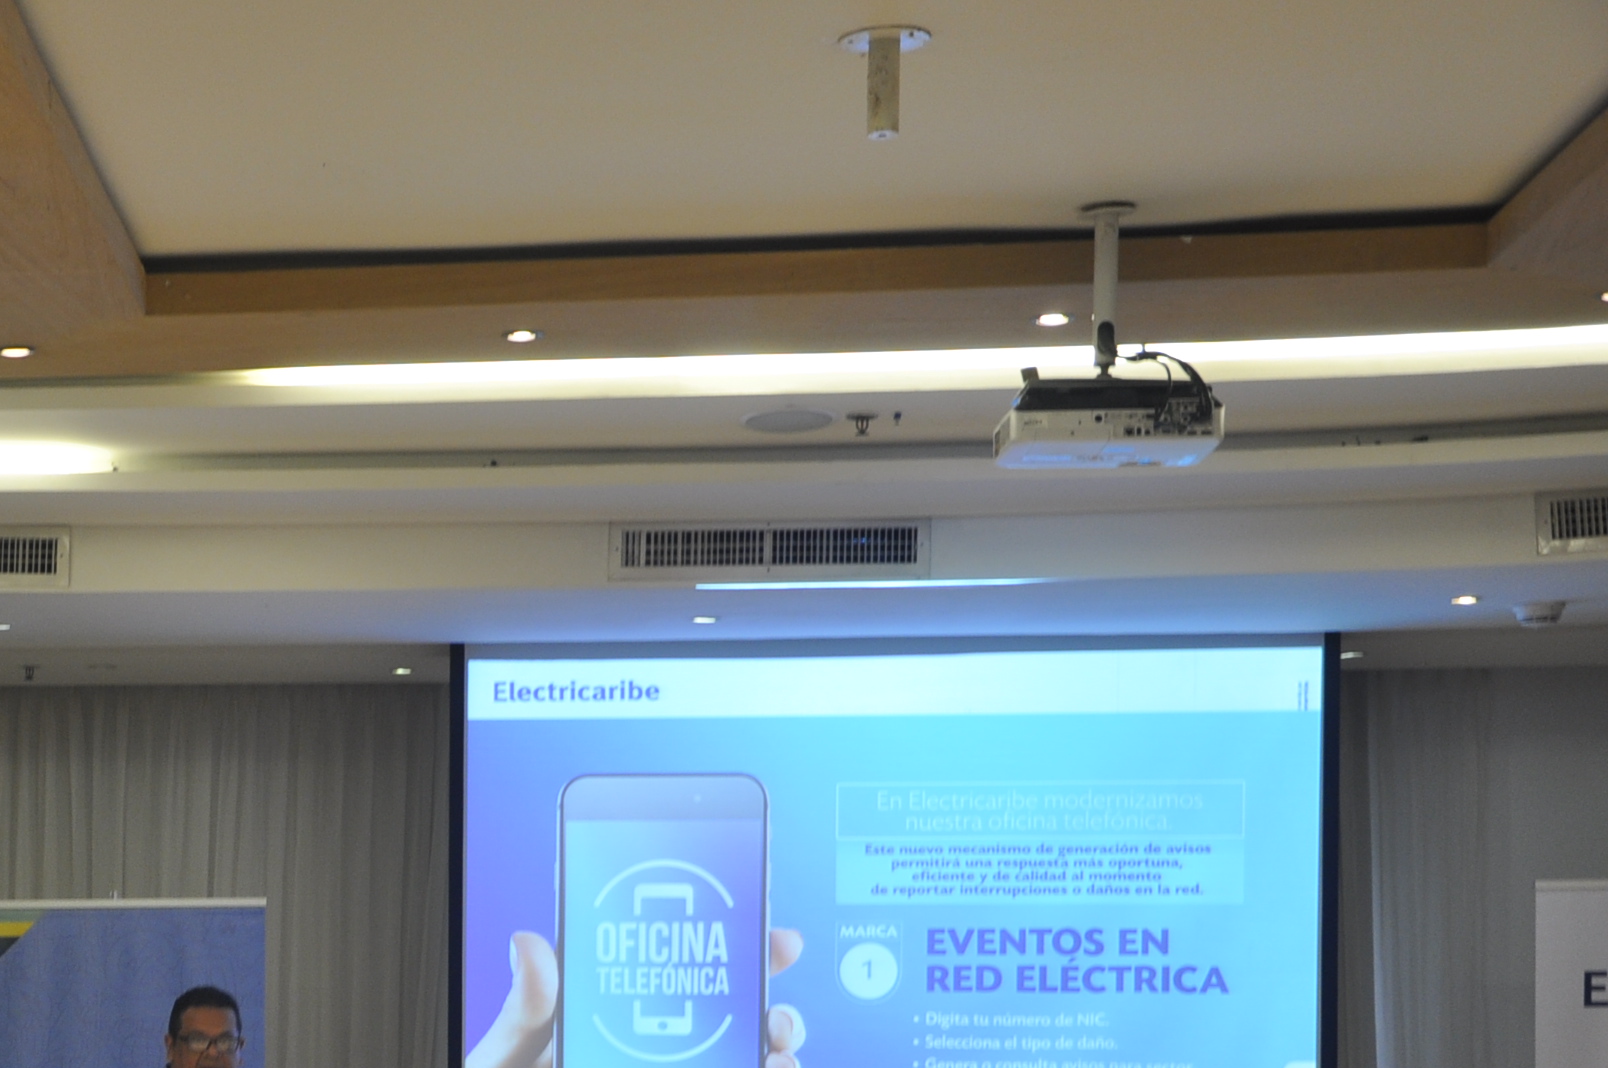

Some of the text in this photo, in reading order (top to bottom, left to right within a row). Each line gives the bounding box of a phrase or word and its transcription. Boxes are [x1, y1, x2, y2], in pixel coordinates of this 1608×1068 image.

[493, 680, 661, 703] Electricaribe
[876, 790, 1204, 812] En Electricaribe modernizamos
[905, 811, 1173, 832] nuestra oficina telefónica.
[864, 842, 1211, 858] Este nuevo mecanismo de generación de avisos
[891, 857, 960, 871] permitirá
[964, 860, 992, 869] una
[996, 858, 1068, 872] respuesta
[1073, 858, 1103, 869] más
[911, 869, 1162, 885] eficiente y de calidad al momento
[870, 883, 1204, 899] de reportar interrupciones o daños en la red.
[596, 920, 728, 964] OFICINA
[839, 924, 898, 939] MARCA
[926, 928, 1170, 956] EVENTOS EN
[596, 961, 729, 996] TELEFÓNICA
[861, 959, 874, 981] 1
[926, 957, 1230, 994] RED ELÉCTRICA
[925, 1011, 1110, 1030] Digita tu número de NIC.
[925, 1035, 1118, 1053] Selecciona el tipo de daño.
